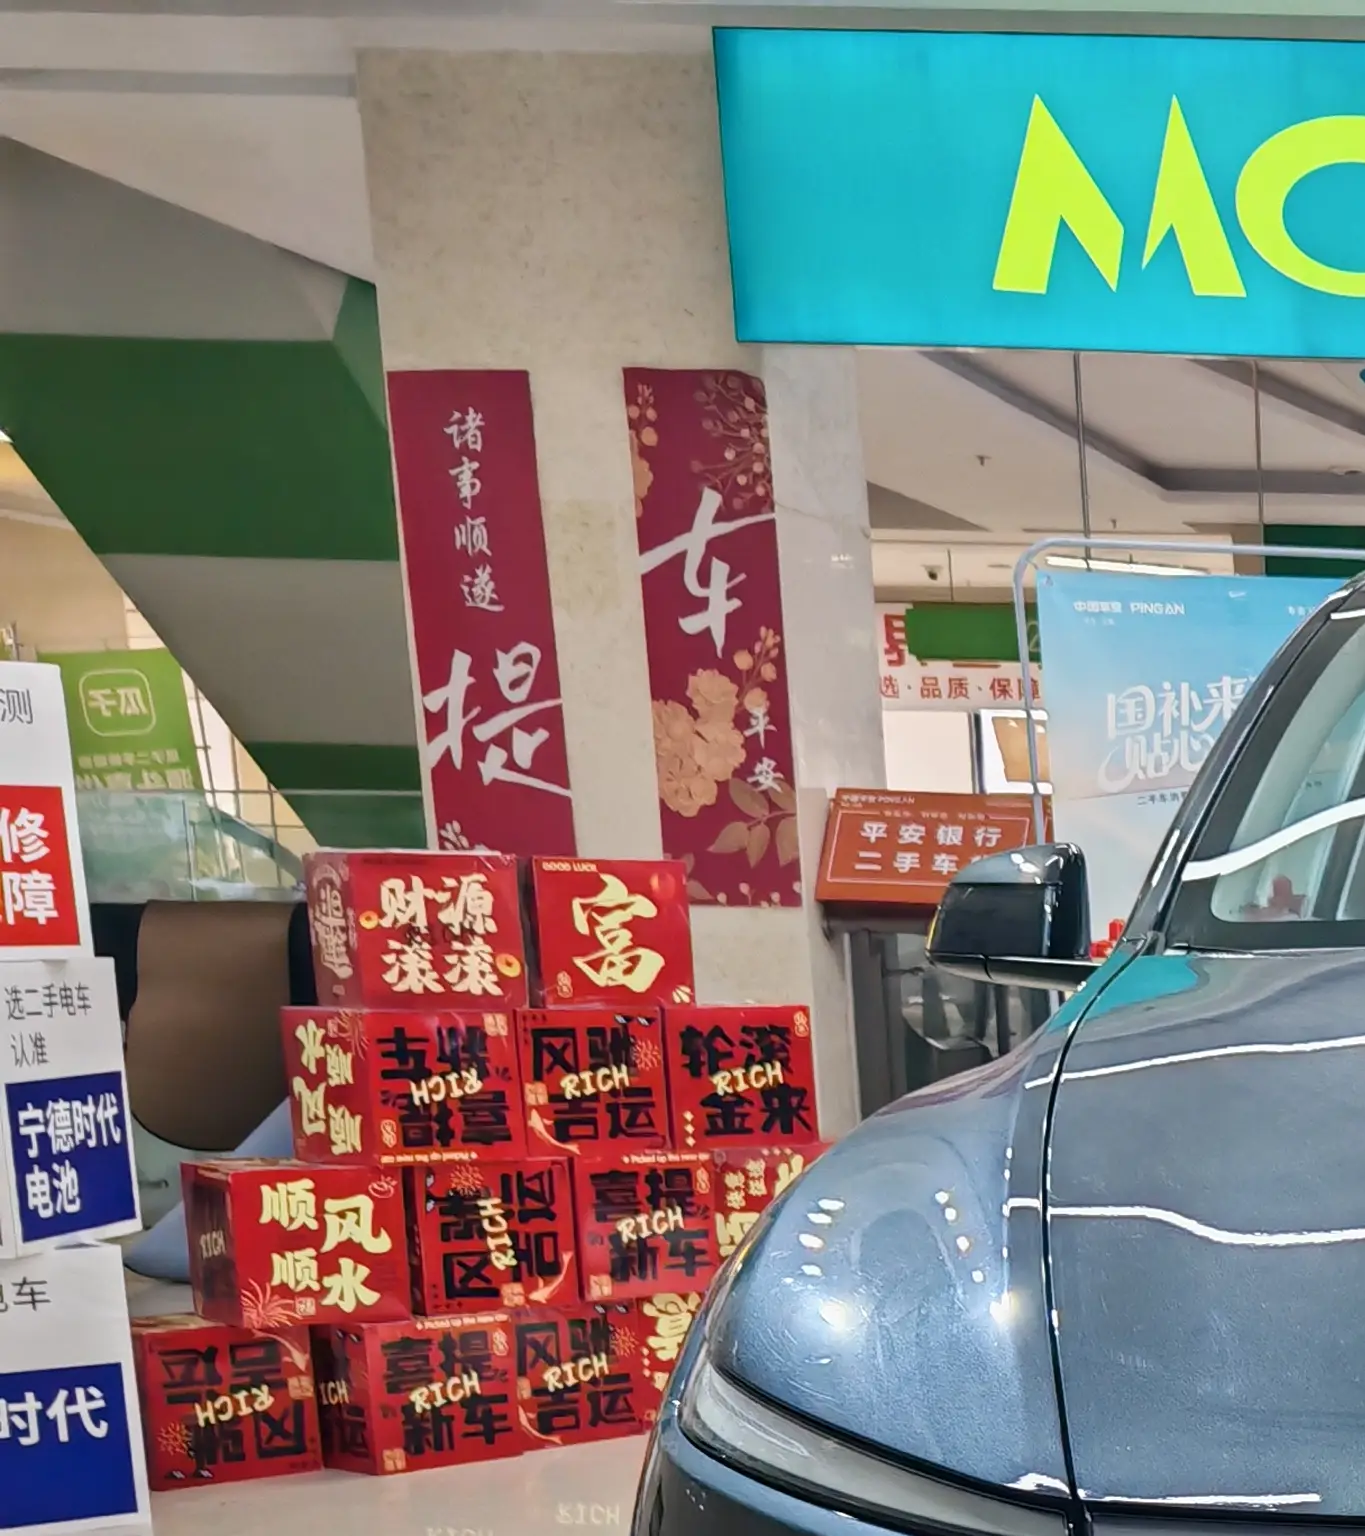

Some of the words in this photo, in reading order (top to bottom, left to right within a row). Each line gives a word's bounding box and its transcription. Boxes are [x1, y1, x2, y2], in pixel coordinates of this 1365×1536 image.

[443, 406, 504, 612] 诸事顺遂
[638, 486, 776, 659] 车
[422, 641, 572, 797] 提
[1107, 675, 1254, 742] 国补来
[743, 707, 783, 793] 平安
[0, 807, 51, 863] 修
[854, 852, 988, 876] 二手车
[860, 821, 1002, 848] 平安银行
[380, 873, 498, 934] 财源
[572, 874, 666, 994] 富
[381, 934, 504, 997] 滚滚
[4, 981, 92, 1021] 选二手电车
[10, 1031, 50, 1068] 认准
[712, 1061, 785, 1096] RICH
[410, 1067, 483, 1106] RICH
[560, 1064, 631, 1099] RICH
[18, 1092, 122, 1159] 宁德时代
[25, 1160, 81, 1219] 电池
[259, 1178, 392, 1255] 顺风
[476, 1197, 518, 1270] RICH
[616, 1206, 684, 1245] RICH
[271, 1248, 381, 1313] 顺水
[410, 1371, 481, 1414] RICH
[543, 1353, 610, 1392] RICH
[194, 1383, 275, 1428] RICH
